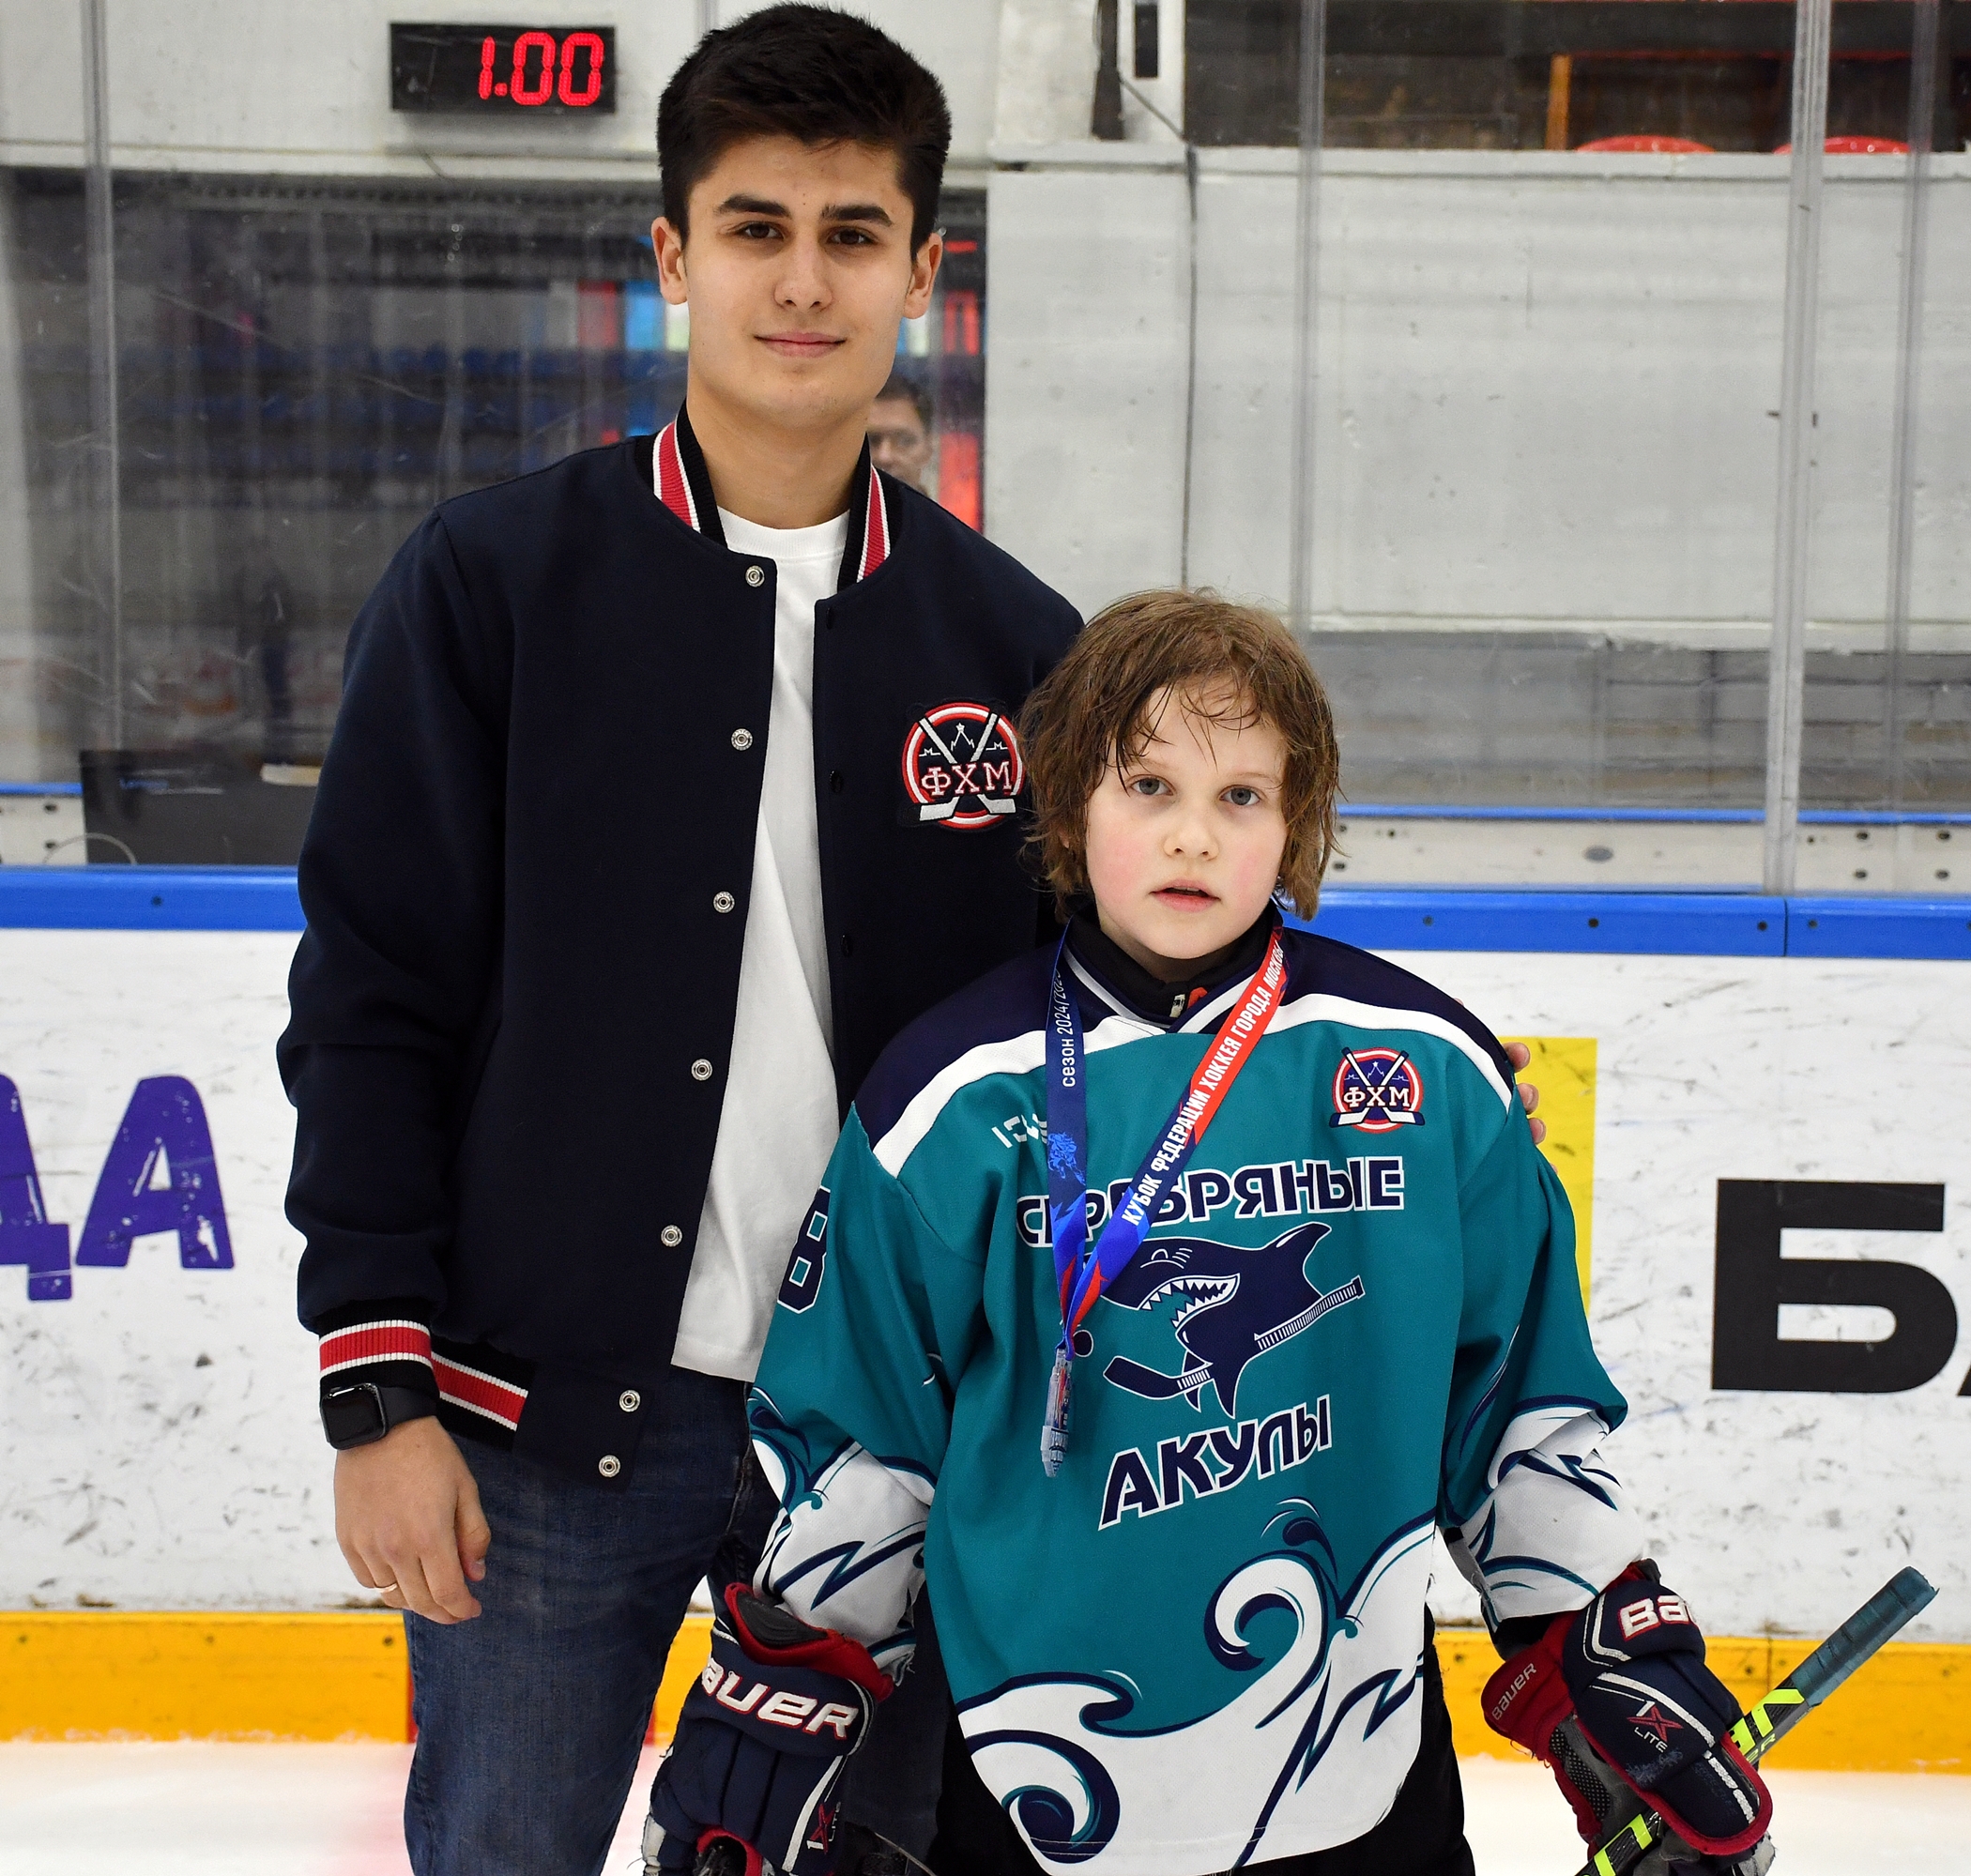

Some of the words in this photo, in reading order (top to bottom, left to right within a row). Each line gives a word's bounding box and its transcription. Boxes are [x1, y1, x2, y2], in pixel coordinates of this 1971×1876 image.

[921, 761, 1013, 797] ФХМ
[1062, 1038, 1077, 1088] сезон
[1122, 1173, 1163, 1227] КУБОК
[1150, 1089, 1212, 1172] ФЕДЕРАЦИИ
[1199, 1036, 1243, 1091] ХОККЕЯ
[1230, 985, 1273, 1039] ГОРОДА
[1262, 939, 1284, 990] МОСКВЫ
[1343, 1086, 1411, 1108] ФХМ
[1711, 1179, 1971, 1396] Б
[1098, 1394, 1333, 1532] АКУЛЫ
[1633, 1726, 1669, 1754] LITE
